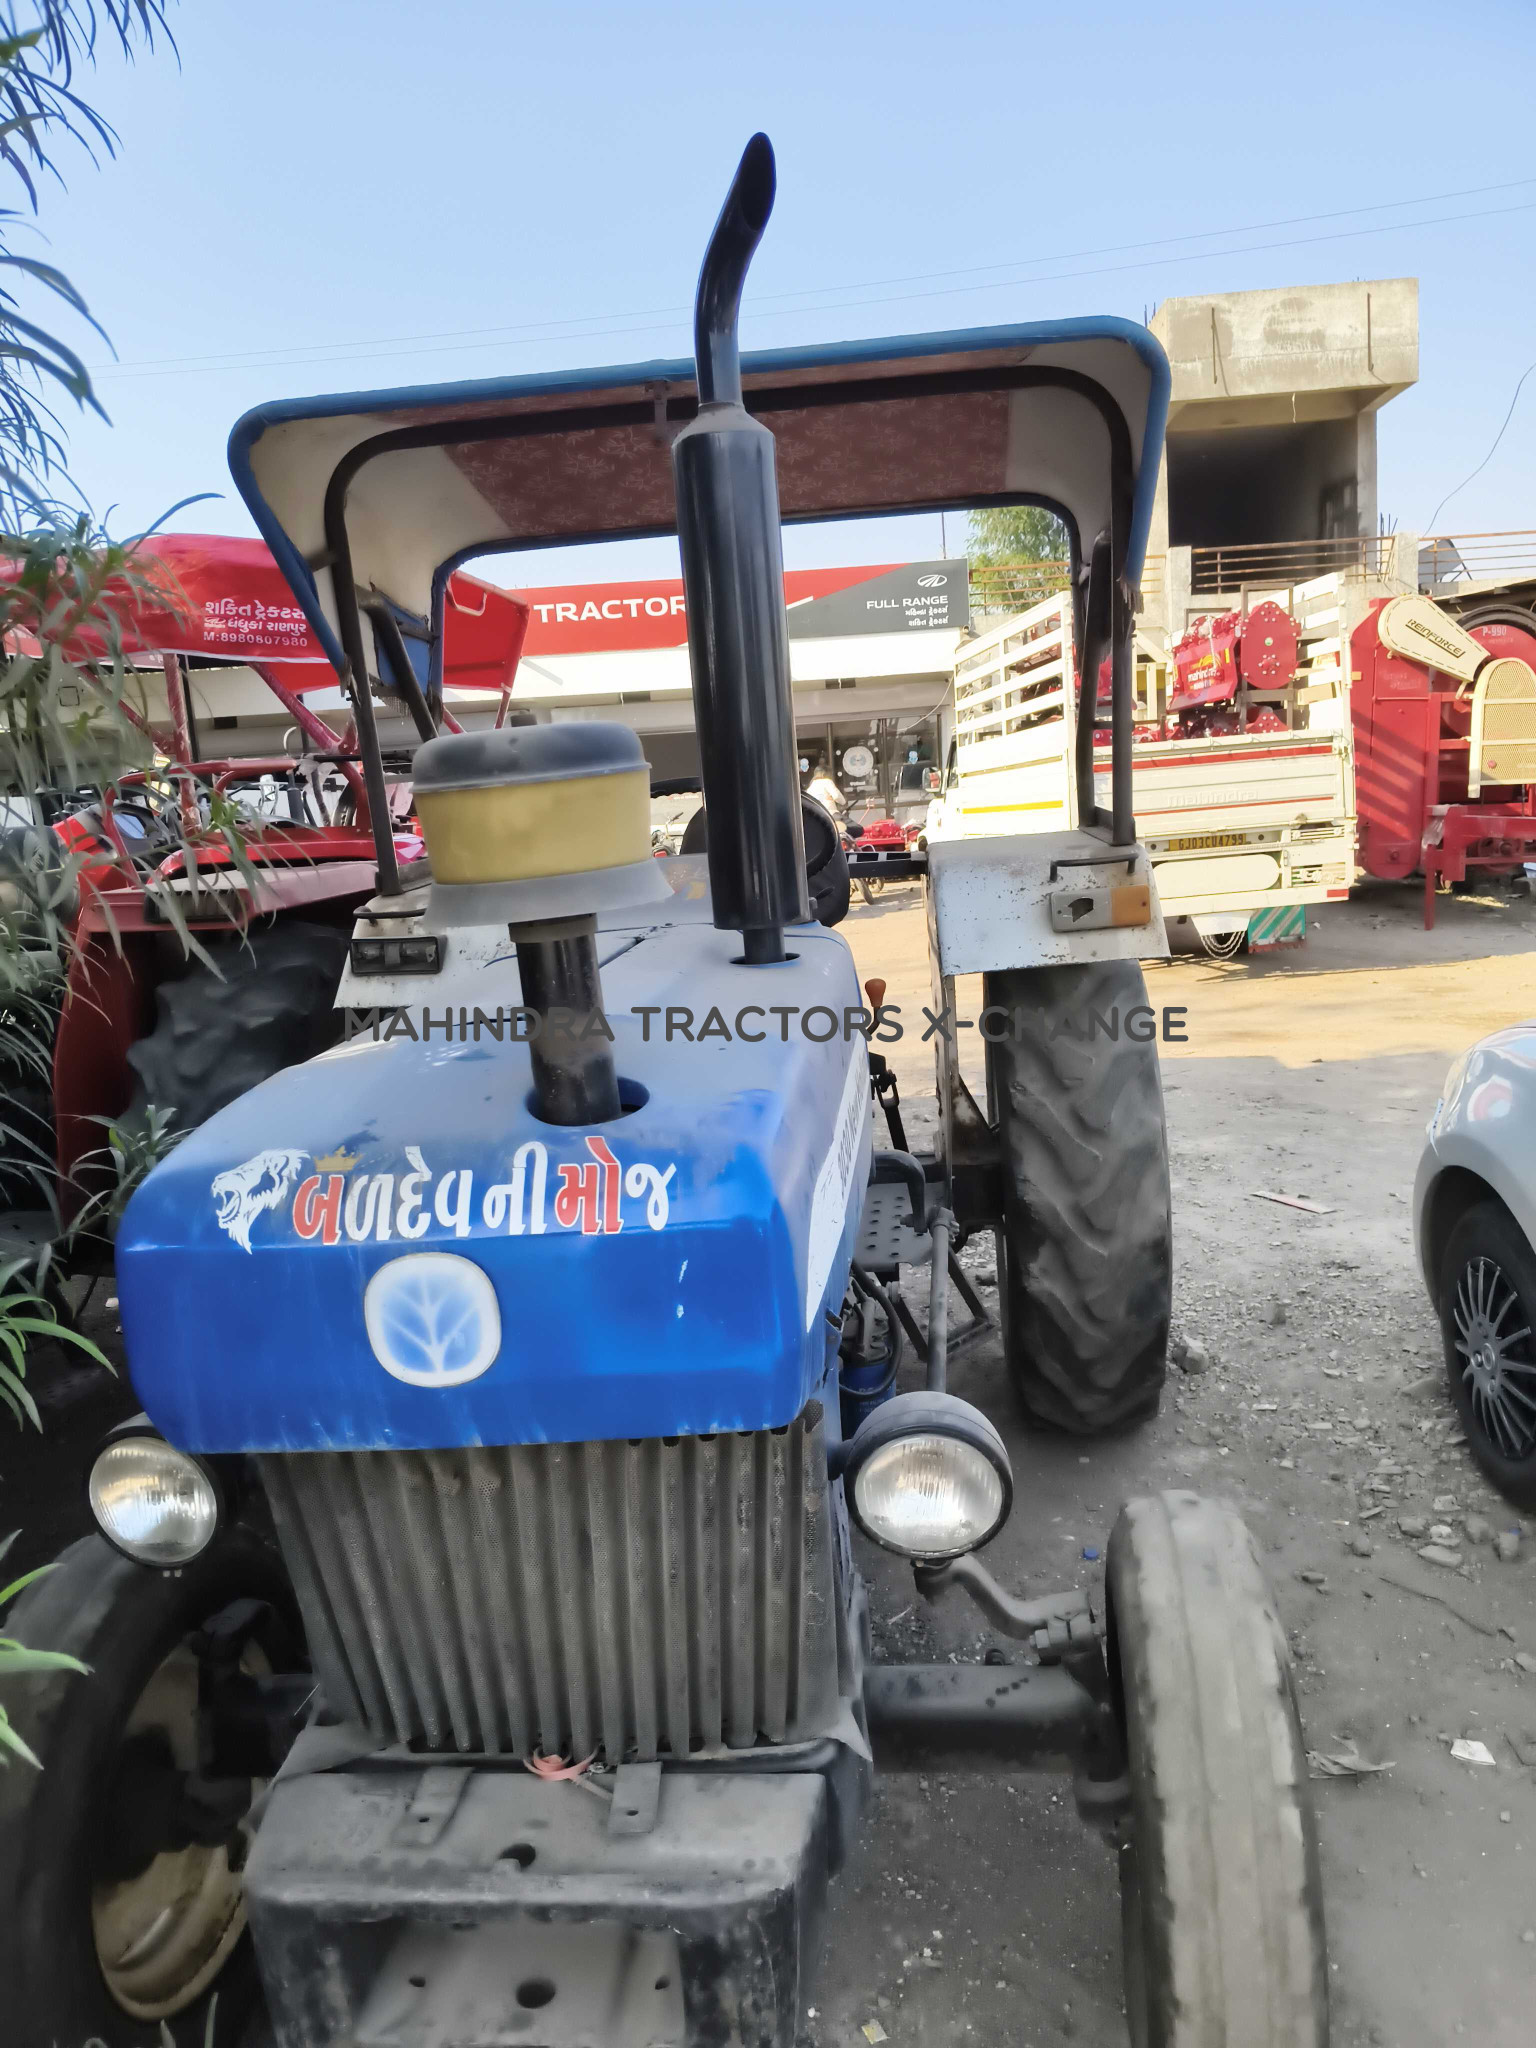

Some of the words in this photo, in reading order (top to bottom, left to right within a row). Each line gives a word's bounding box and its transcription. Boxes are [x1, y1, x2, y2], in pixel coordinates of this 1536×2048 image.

[866, 599, 900, 610] FULL
[902, 595, 949, 607] RANGE
[1407, 619, 1462, 655] REINFORCE
[482, 1141, 548, 1235] ની
[556, 1136, 677, 1235] મોજ
